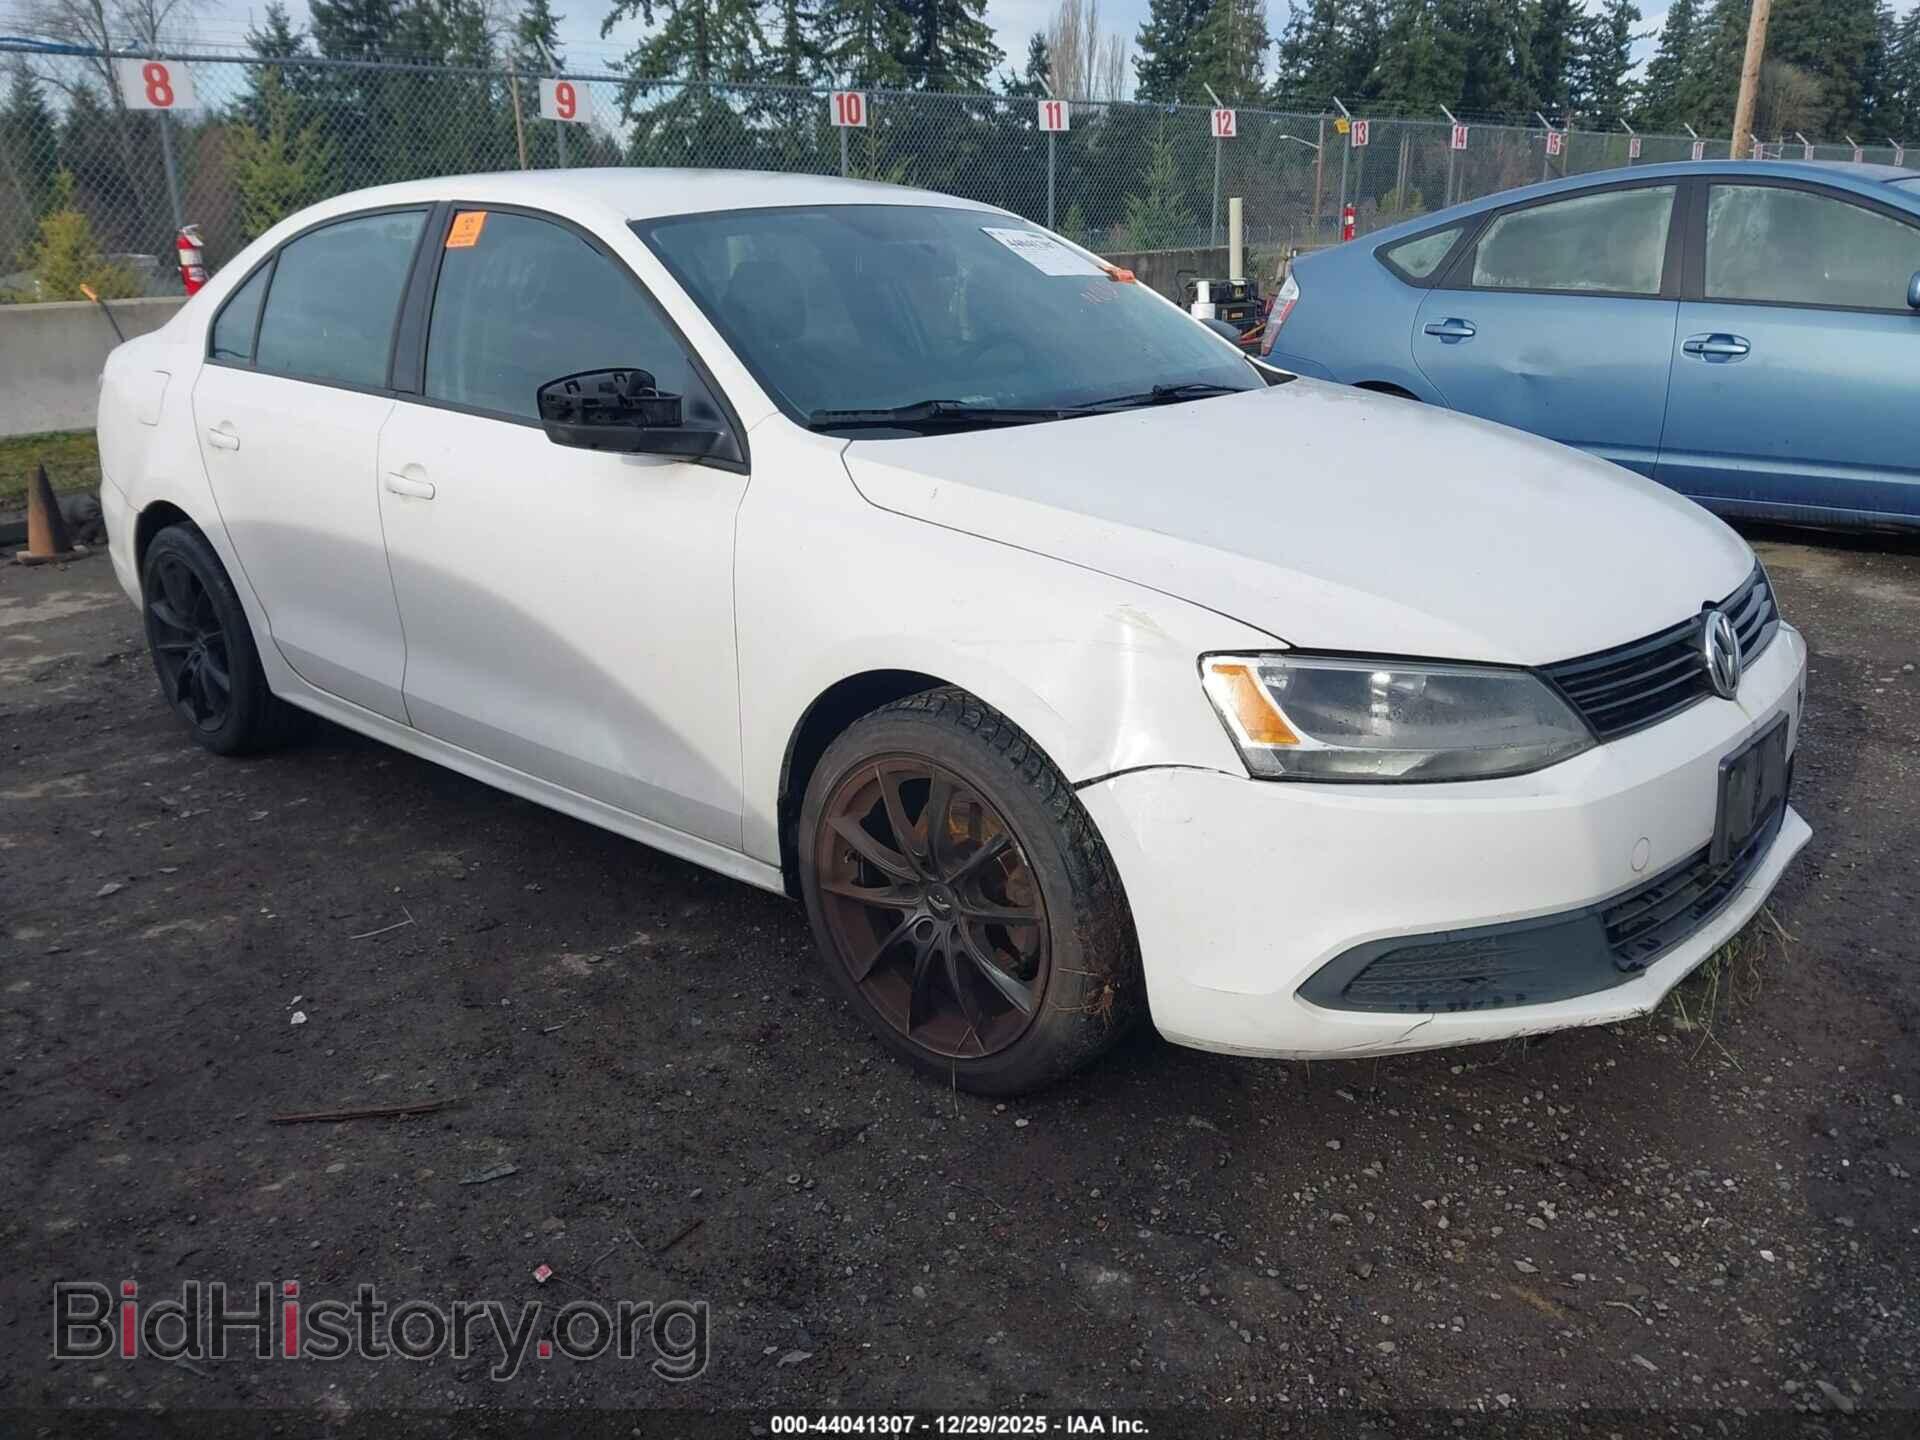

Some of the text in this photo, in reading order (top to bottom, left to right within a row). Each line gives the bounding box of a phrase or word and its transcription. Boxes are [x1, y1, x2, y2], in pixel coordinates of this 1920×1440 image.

[143, 62, 174, 108] 8
[554, 82, 577, 119] 9
[836, 93, 862, 125] 10
[1045, 103, 1062, 128] 11
[1215, 112, 1232, 135] 12
[1355, 122, 1366, 145] 13
[1455, 128, 1465, 148] 14
[1550, 134, 1560, 153] 15
